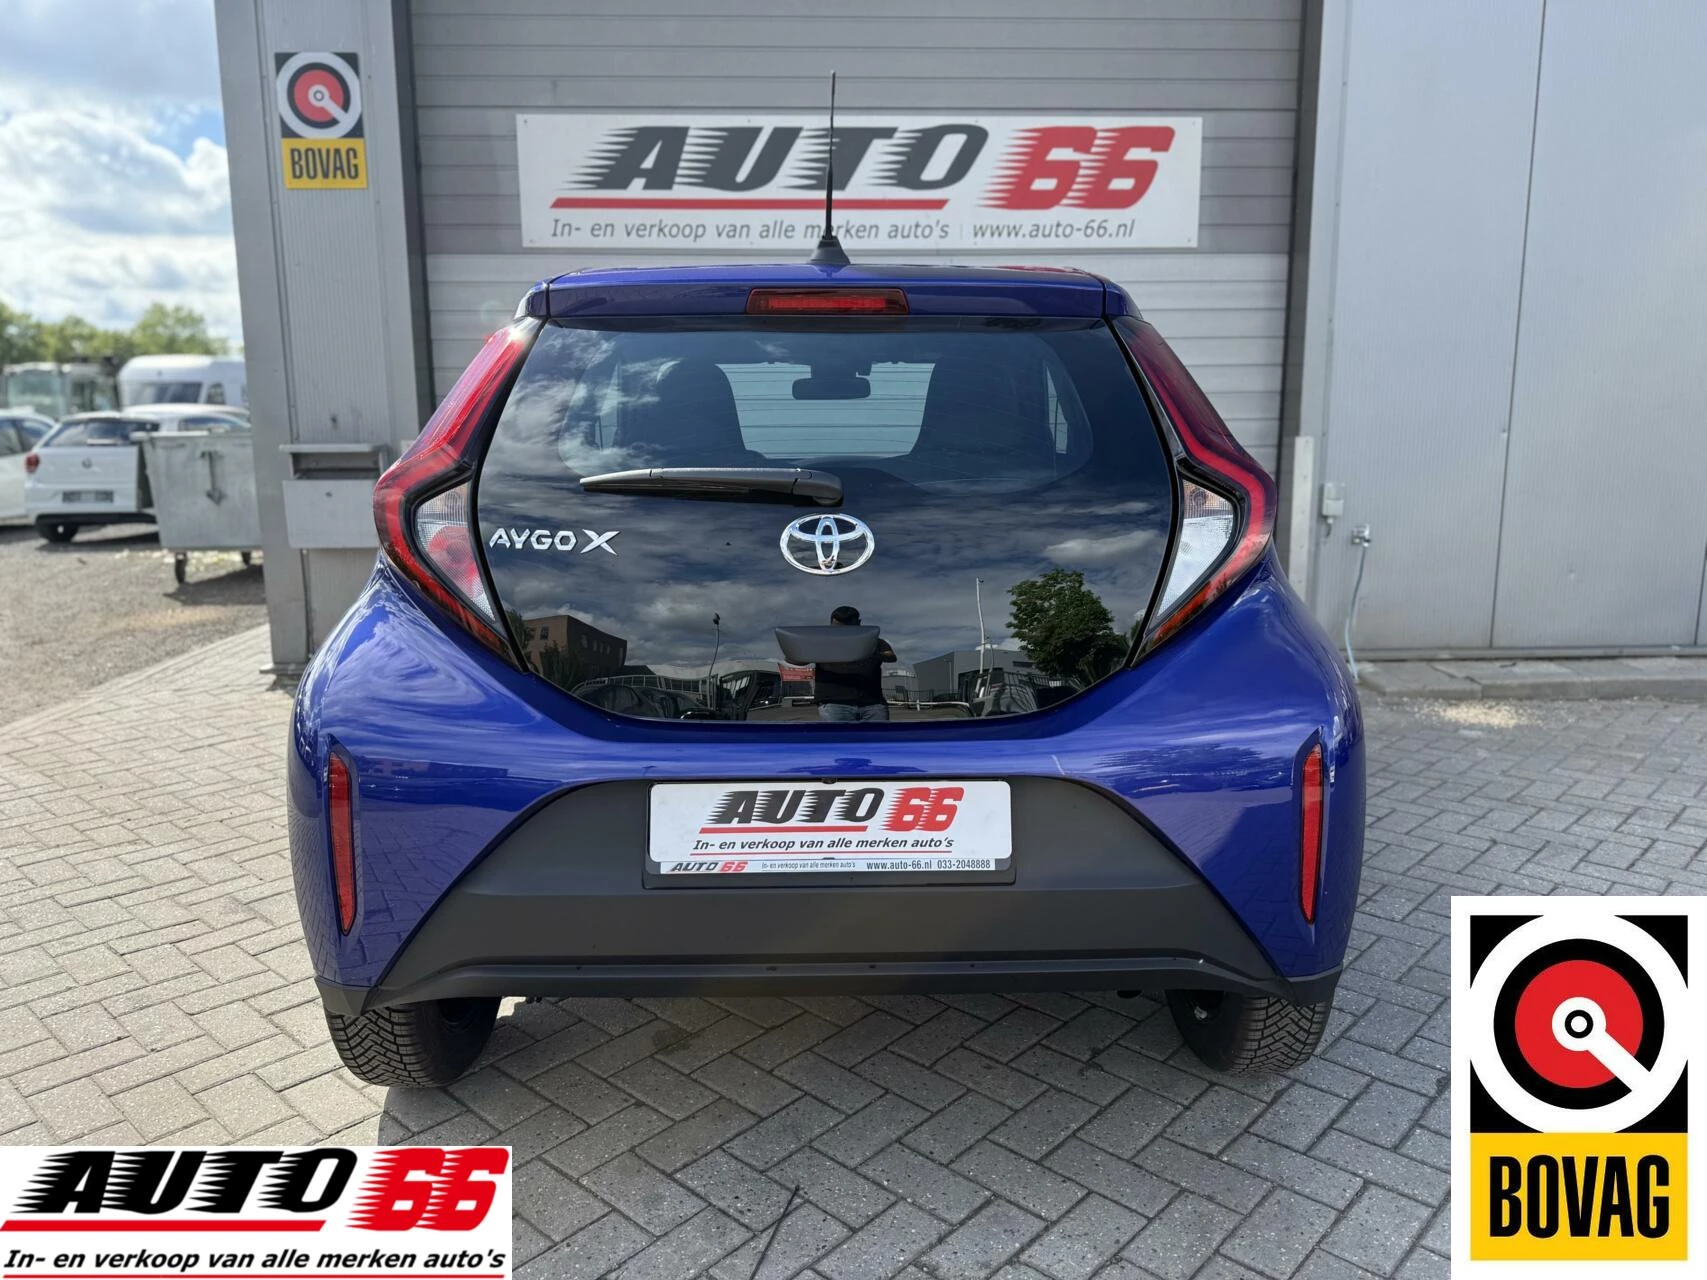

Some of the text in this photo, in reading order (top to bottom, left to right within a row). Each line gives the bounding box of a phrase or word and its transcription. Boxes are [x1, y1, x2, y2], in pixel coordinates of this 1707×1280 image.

[290, 147, 359, 180] BOVAG
[557, 124, 1176, 210] AUTO 66
[551, 219, 581, 238] In-
[590, 223, 615, 238] en
[624, 220, 706, 243] verkoop
[715, 224, 750, 239] van
[759, 220, 796, 239] alle
[888, 220, 950, 240] auto's
[973, 219, 1136, 239] www.auto-66.nl
[489, 528, 620, 555] AYGO X
[705, 786, 964, 831] AUTO 66
[692, 836, 955, 851] In- en verkoop van alle merken auto's
[669, 862, 717, 872] AUTO
[718, 861, 749, 872] 66
[866, 860, 932, 869] www.auto-66.nl
[937, 860, 991, 870] 033-2048888
